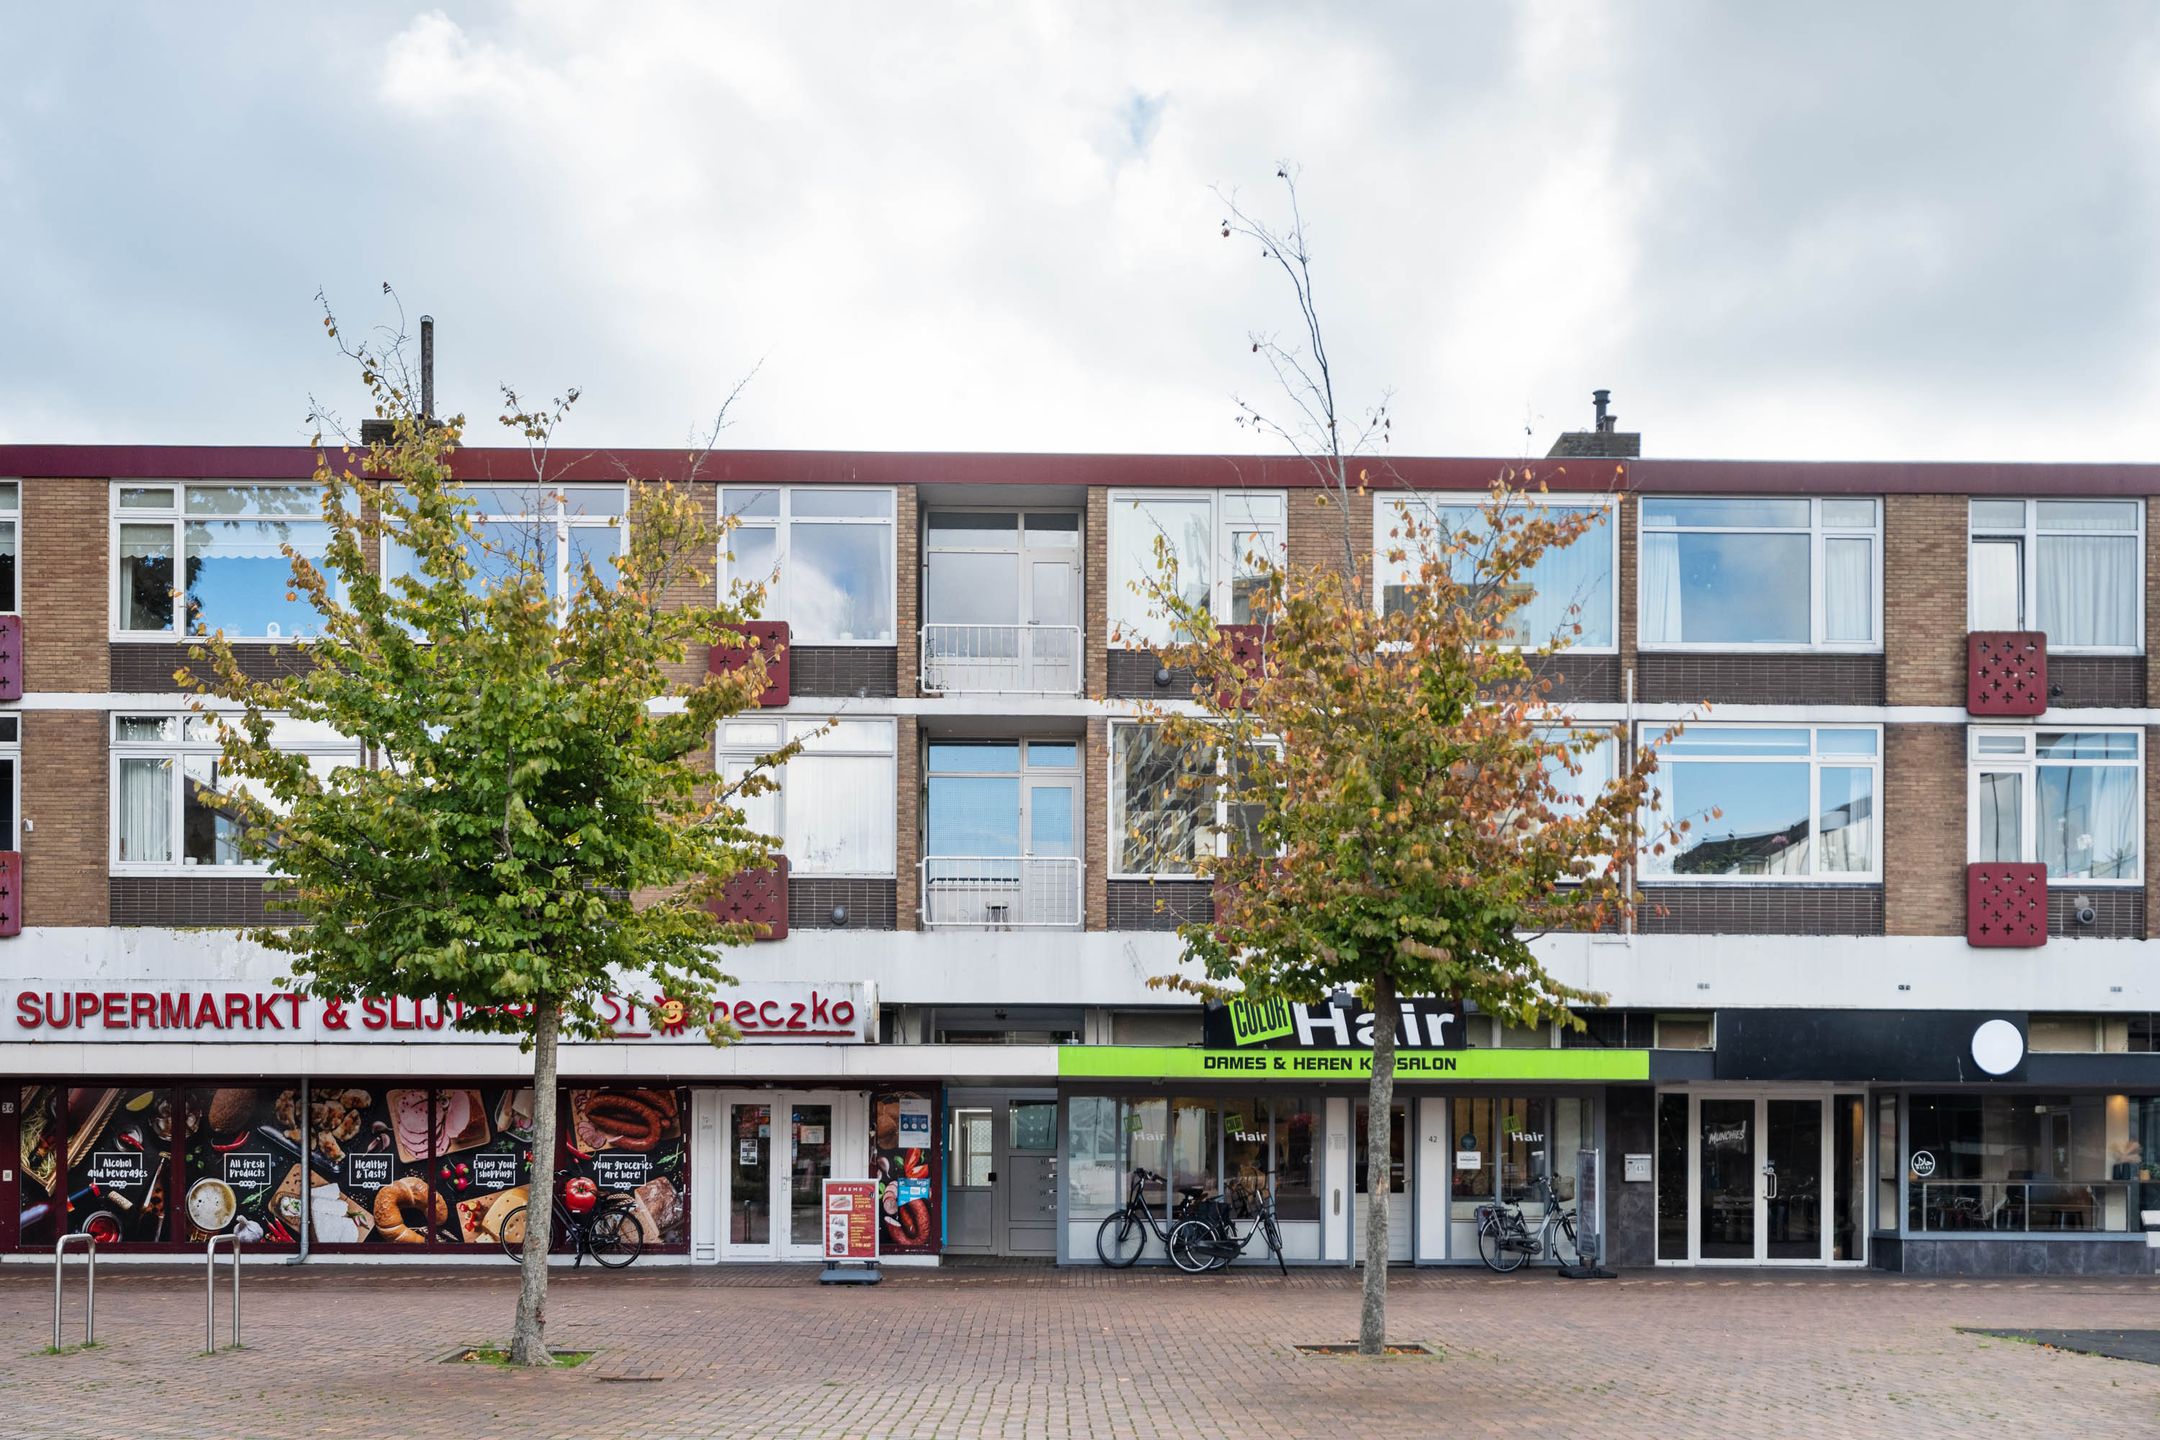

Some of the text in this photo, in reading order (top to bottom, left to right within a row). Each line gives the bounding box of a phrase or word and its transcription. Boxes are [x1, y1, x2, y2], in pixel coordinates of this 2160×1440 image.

[16, 991, 309, 1030] SUPERMARKT
[322, 997, 351, 1031] &
[1234, 996, 1289, 1038] COLOR
[1204, 1056, 1457, 1071] DAMES & HEREN KSALON
[1133, 1131, 1166, 1141] Hair
[1235, 1131, 1268, 1141] Hair
[1428, 1135, 1438, 1143] 42
[1512, 1131, 1544, 1142] Hair
[103, 1158, 132, 1168] Alcohol
[230, 1159, 265, 1169] All fresh
[355, 1160, 388, 1170] Healthy
[473, 1160, 495, 1170] Enjoy
[614, 1160, 653, 1170] groceries
[87, 1168, 148, 1178] and beverages
[356, 1169, 387, 1179] & Tasty
[479, 1169, 513, 1179] shopping!
[604, 1170, 641, 1179] are here!
